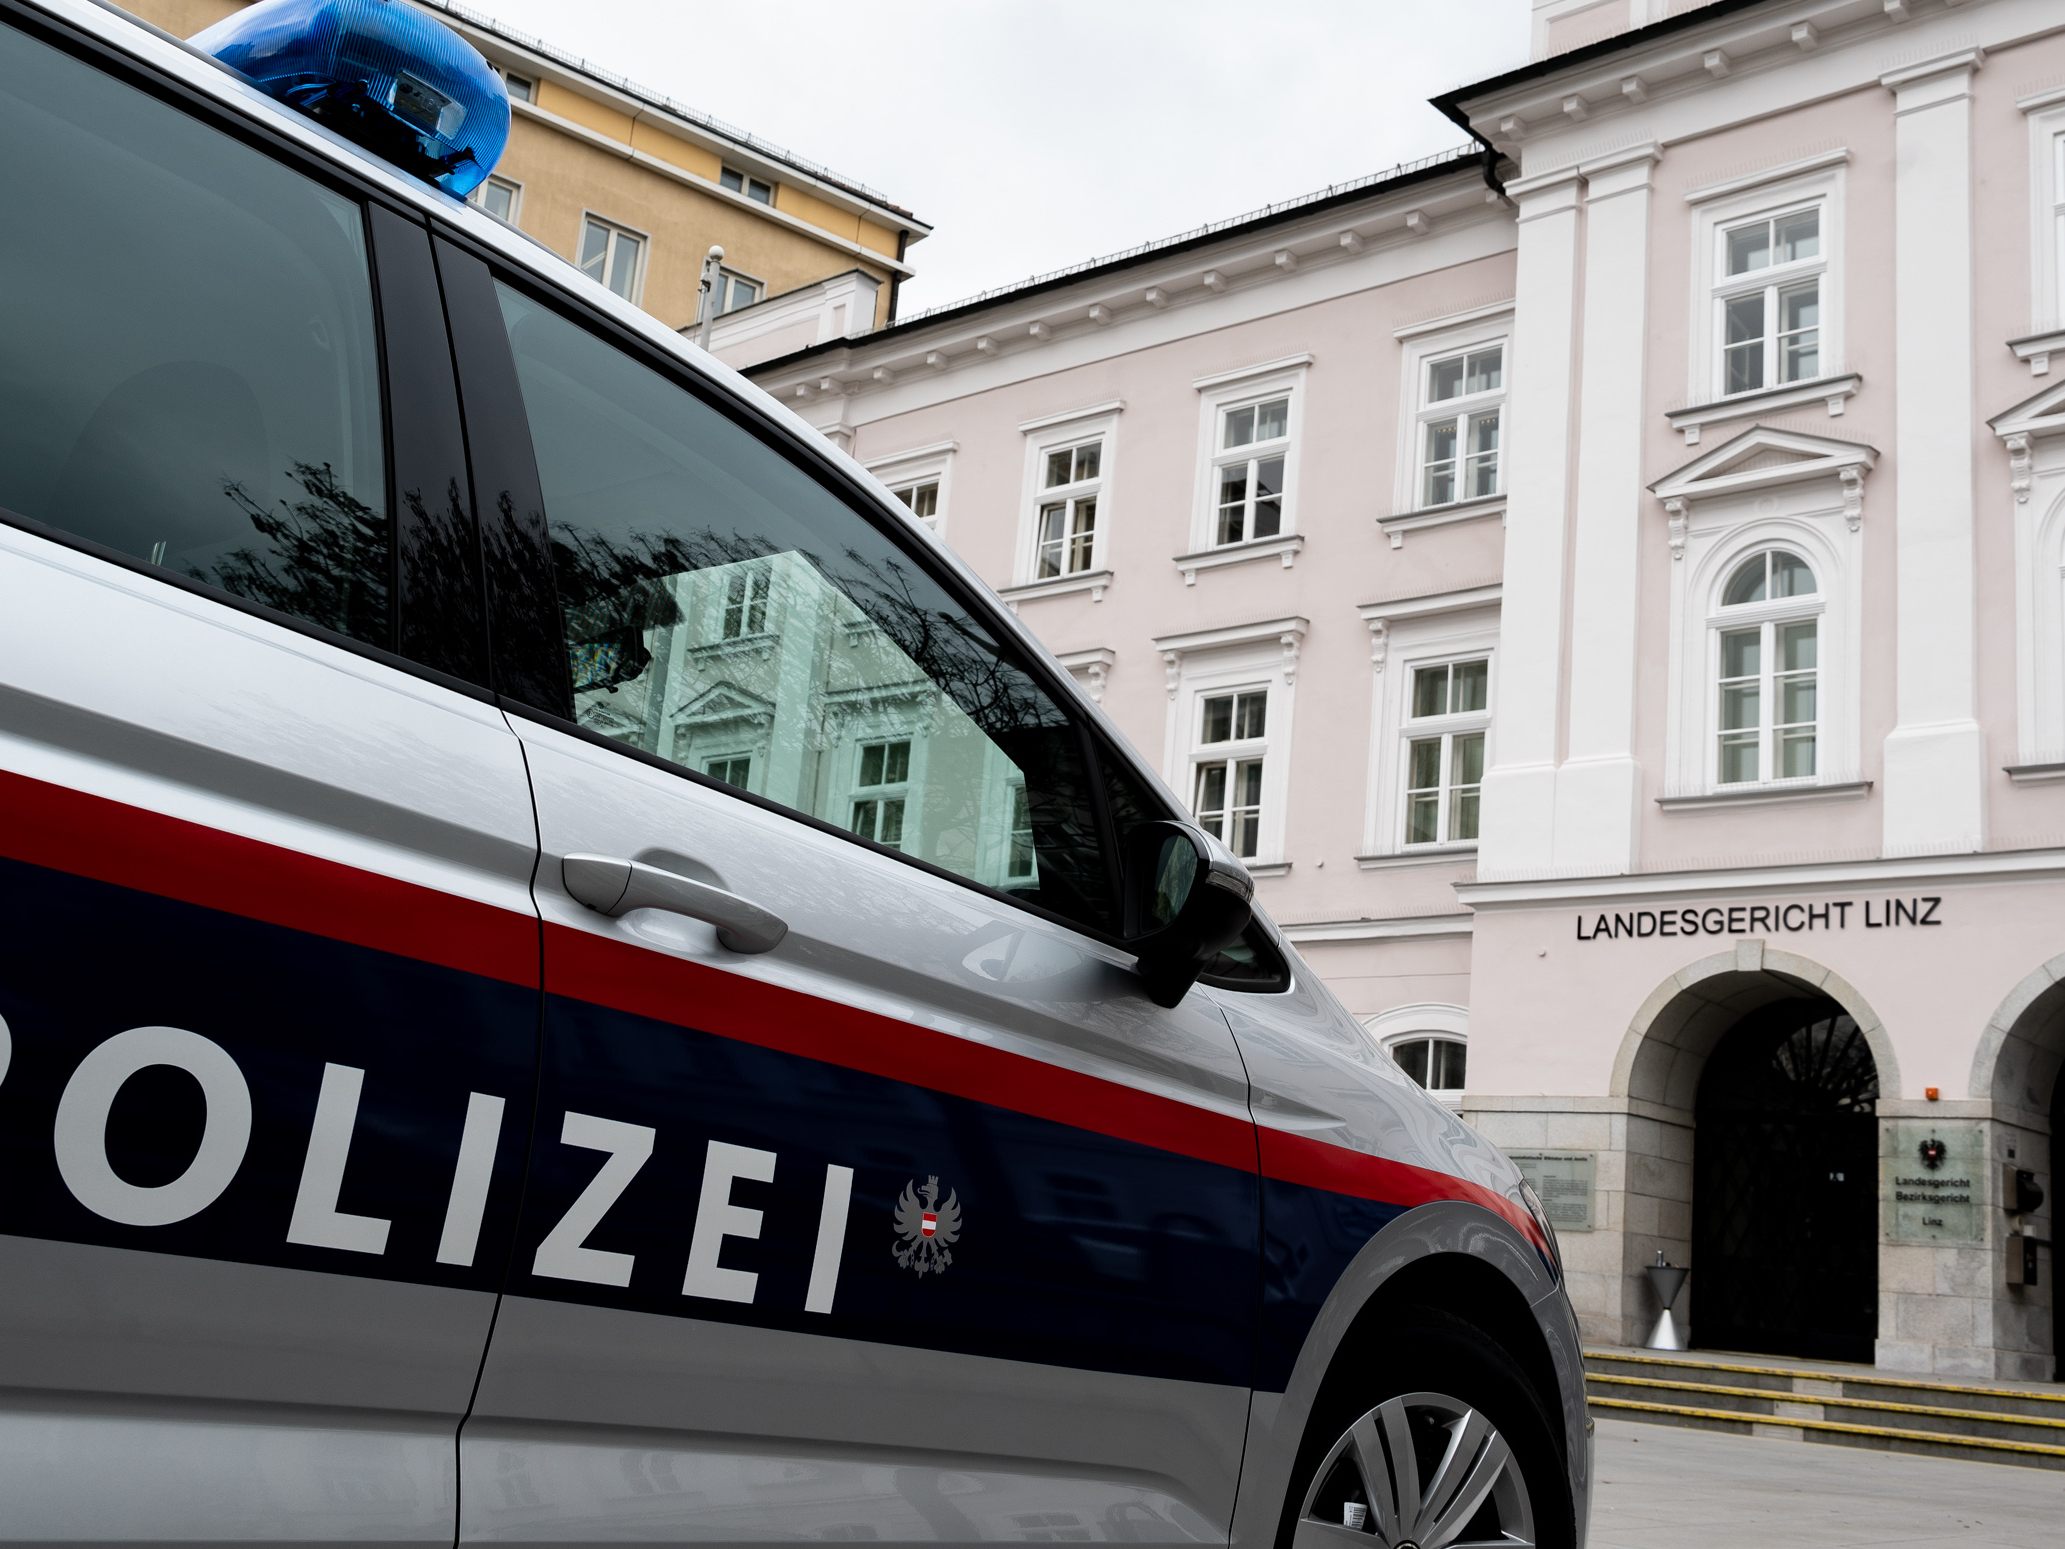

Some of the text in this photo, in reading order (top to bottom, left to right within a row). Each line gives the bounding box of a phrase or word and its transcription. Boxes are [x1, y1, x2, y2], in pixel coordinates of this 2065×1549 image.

[1576, 896, 1942, 940] LANDESGERICHT LINZ
[0, 1012, 854, 1315] OLIZEI
[1895, 1176, 1970, 1188] Landesgericht
[1895, 1191, 1970, 1204] Bezirksgericht
[1922, 1216, 1943, 1227] Linz
